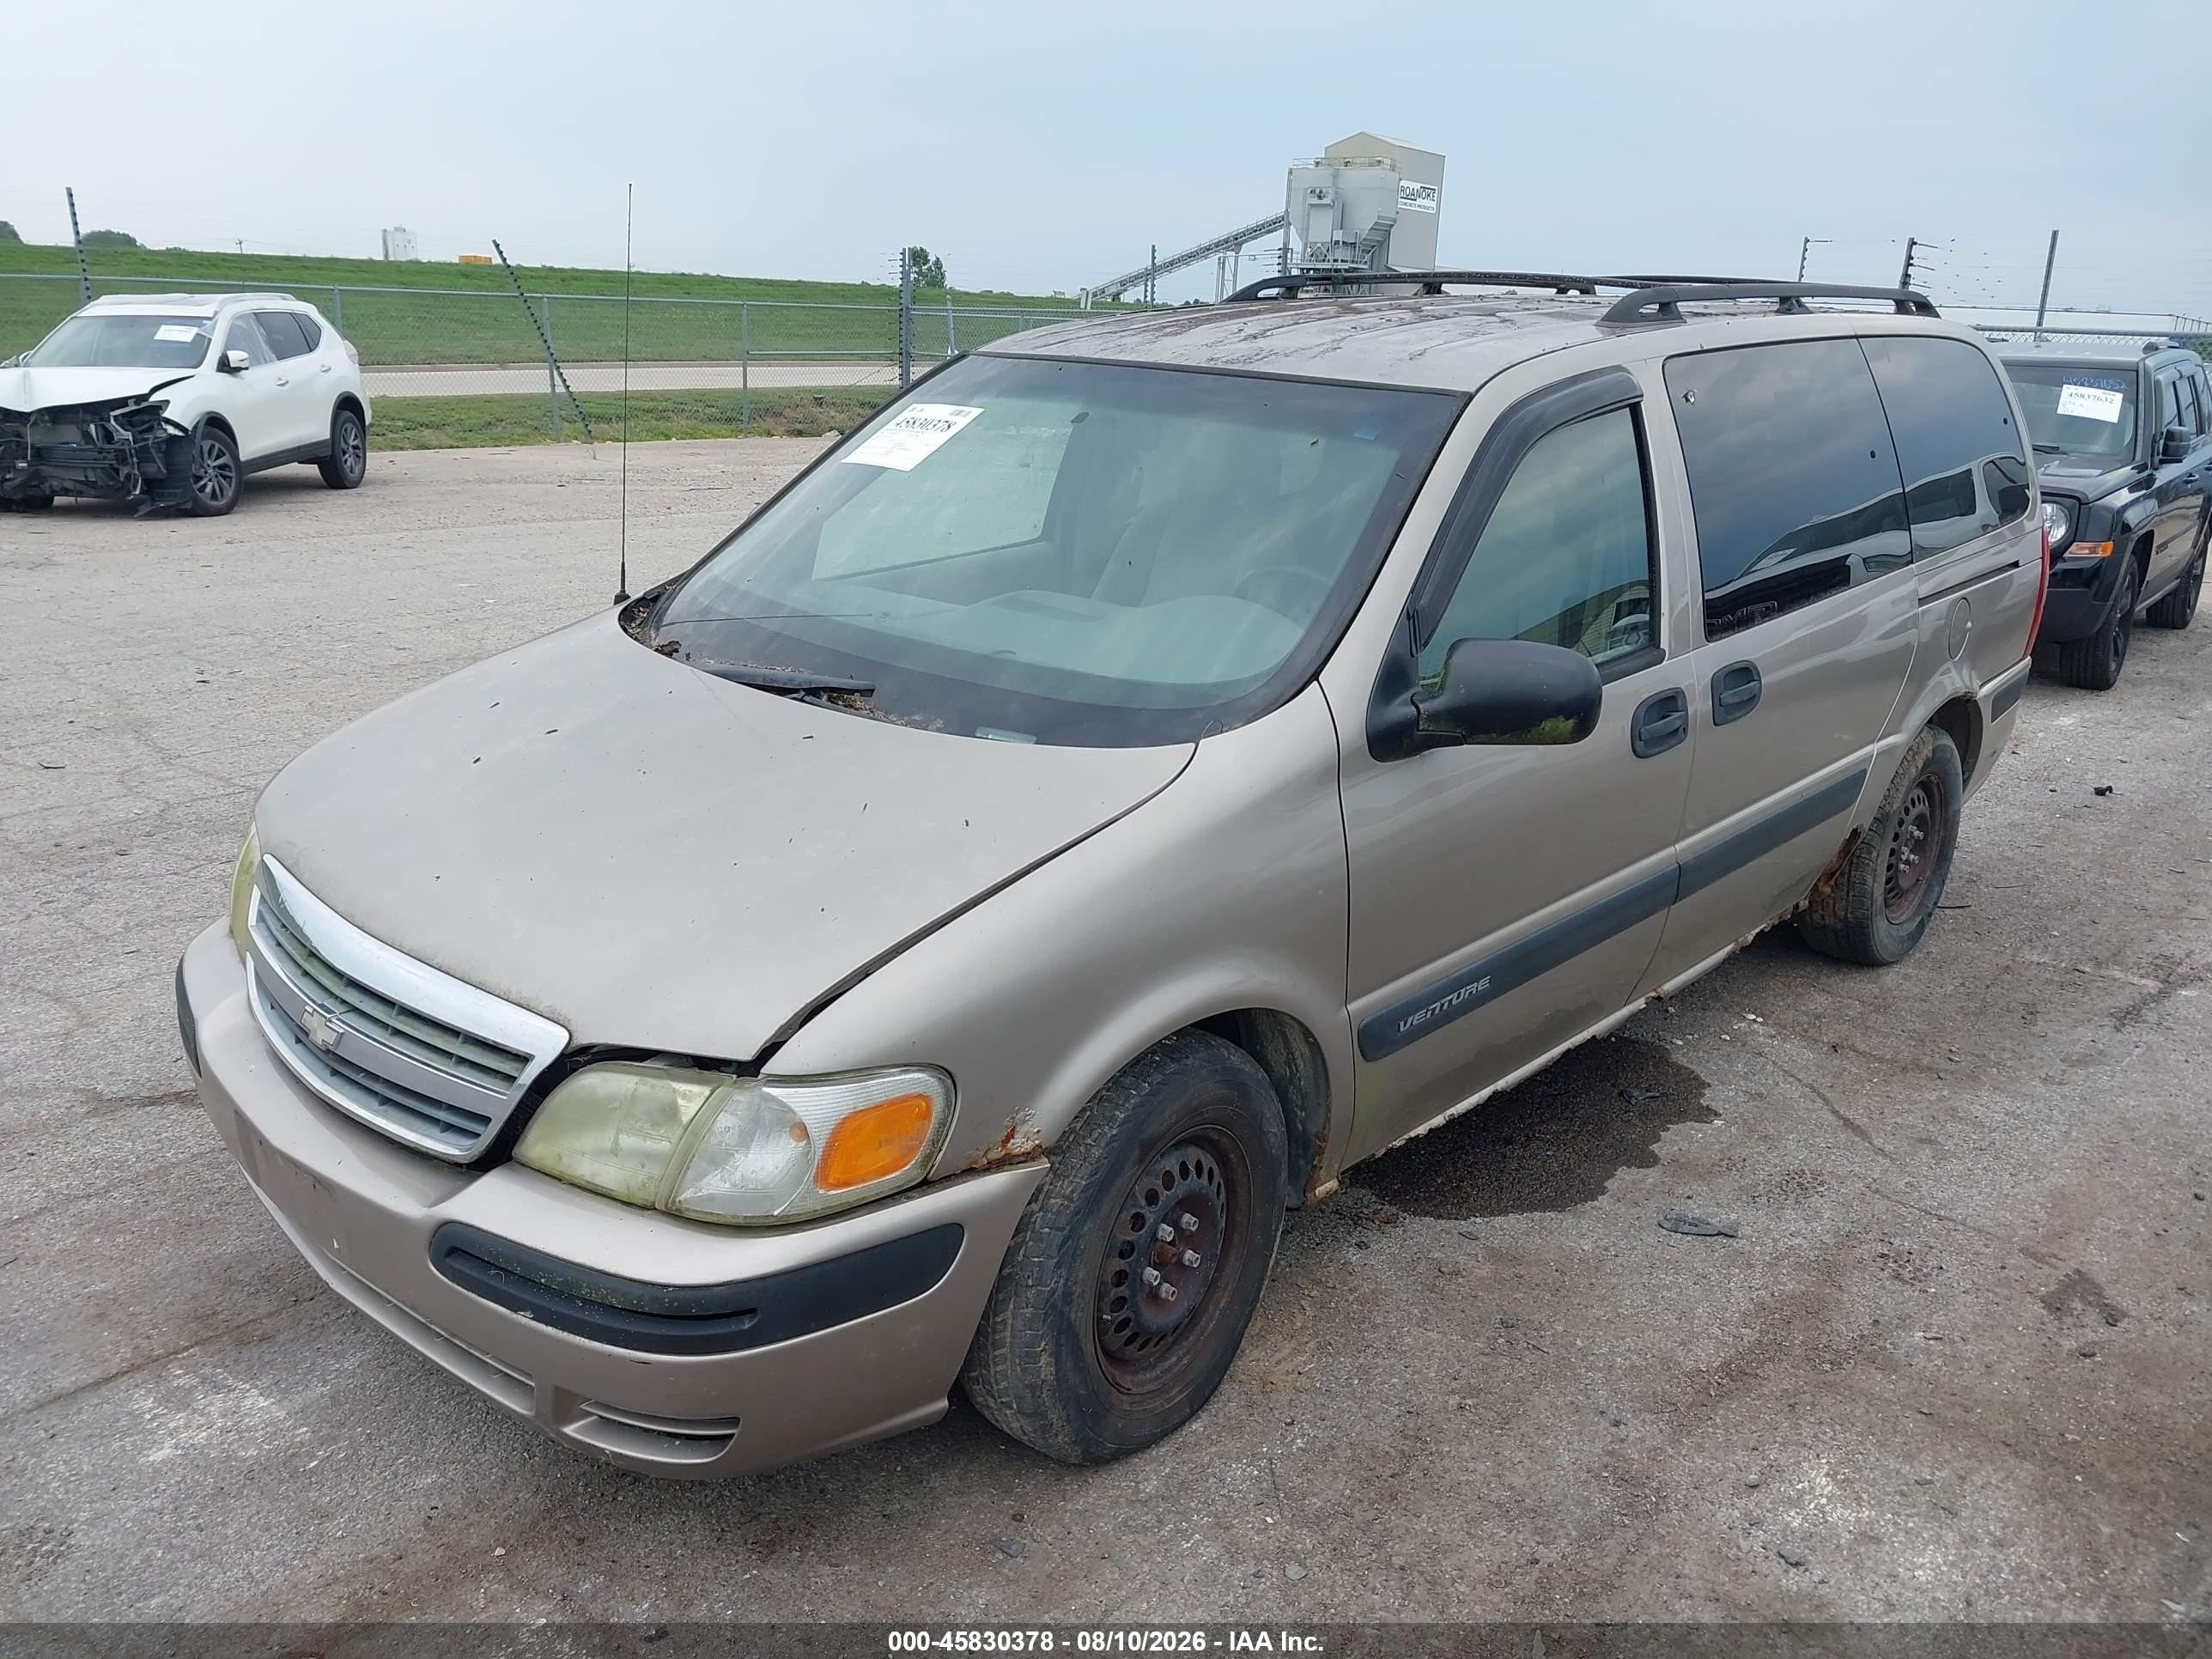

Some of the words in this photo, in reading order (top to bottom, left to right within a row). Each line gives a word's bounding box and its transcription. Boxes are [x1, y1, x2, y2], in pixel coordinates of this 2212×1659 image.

[1400, 185, 1436, 202] ROANOKE
[895, 416, 957, 433] 45830378
[1398, 975, 1492, 1032] VENTURE
